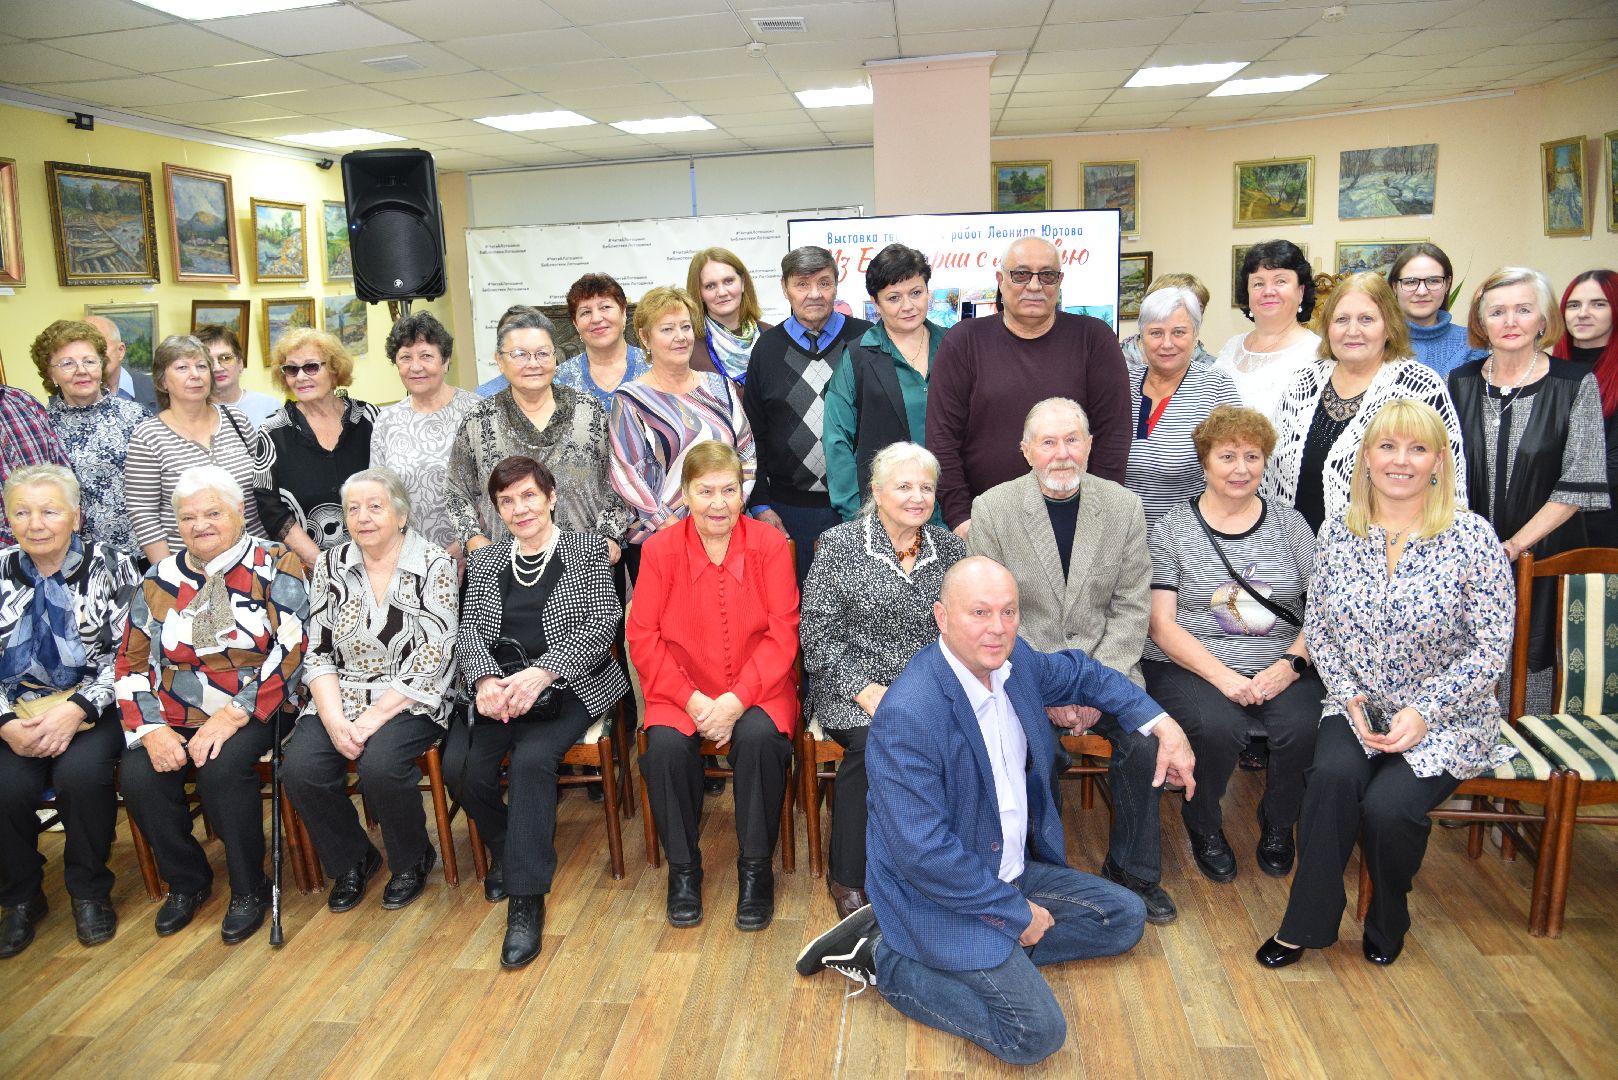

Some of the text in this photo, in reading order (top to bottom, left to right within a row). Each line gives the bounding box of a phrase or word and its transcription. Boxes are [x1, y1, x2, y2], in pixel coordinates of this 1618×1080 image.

[827, 232, 878, 244] Выставка
[951, 226, 982, 242] работ
[1041, 224, 1083, 239] Юртова
